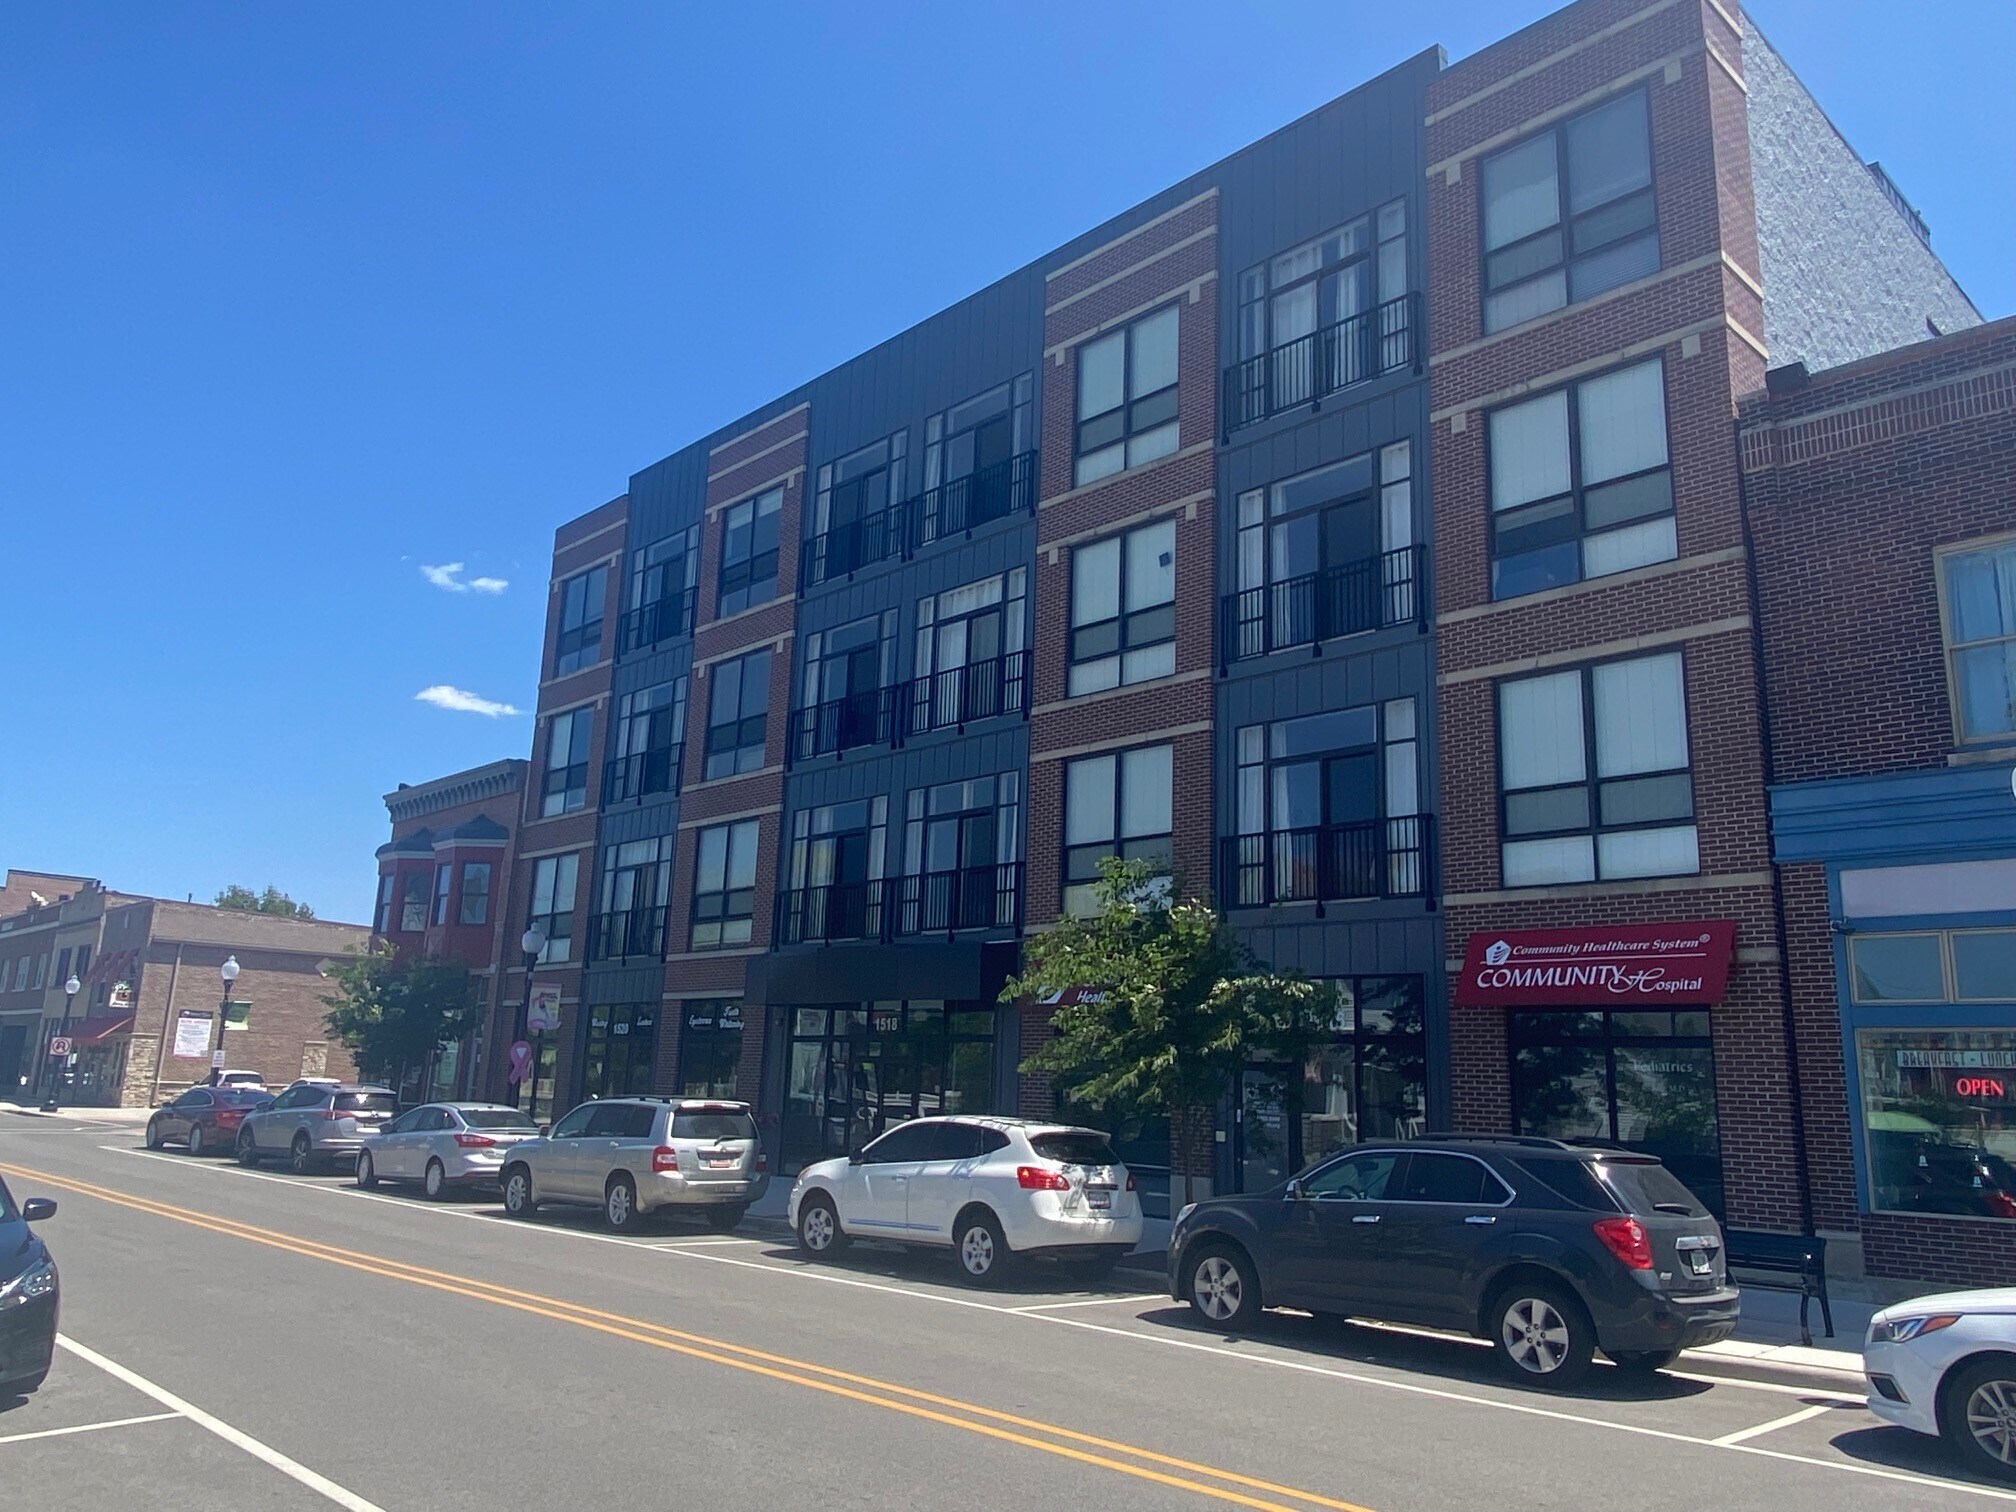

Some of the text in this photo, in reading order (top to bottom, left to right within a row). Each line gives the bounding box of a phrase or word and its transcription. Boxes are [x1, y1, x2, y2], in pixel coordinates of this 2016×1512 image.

[1513, 943, 1580, 956] Community
[1583, 940, 1650, 953] Healthcare
[1477, 965, 1626, 988] COMMUNITY
[875, 1017, 898, 1031] 1518
[1902, 1051, 1965, 1067] BREAKFAST
[1956, 1078, 2004, 1096] OPEN
